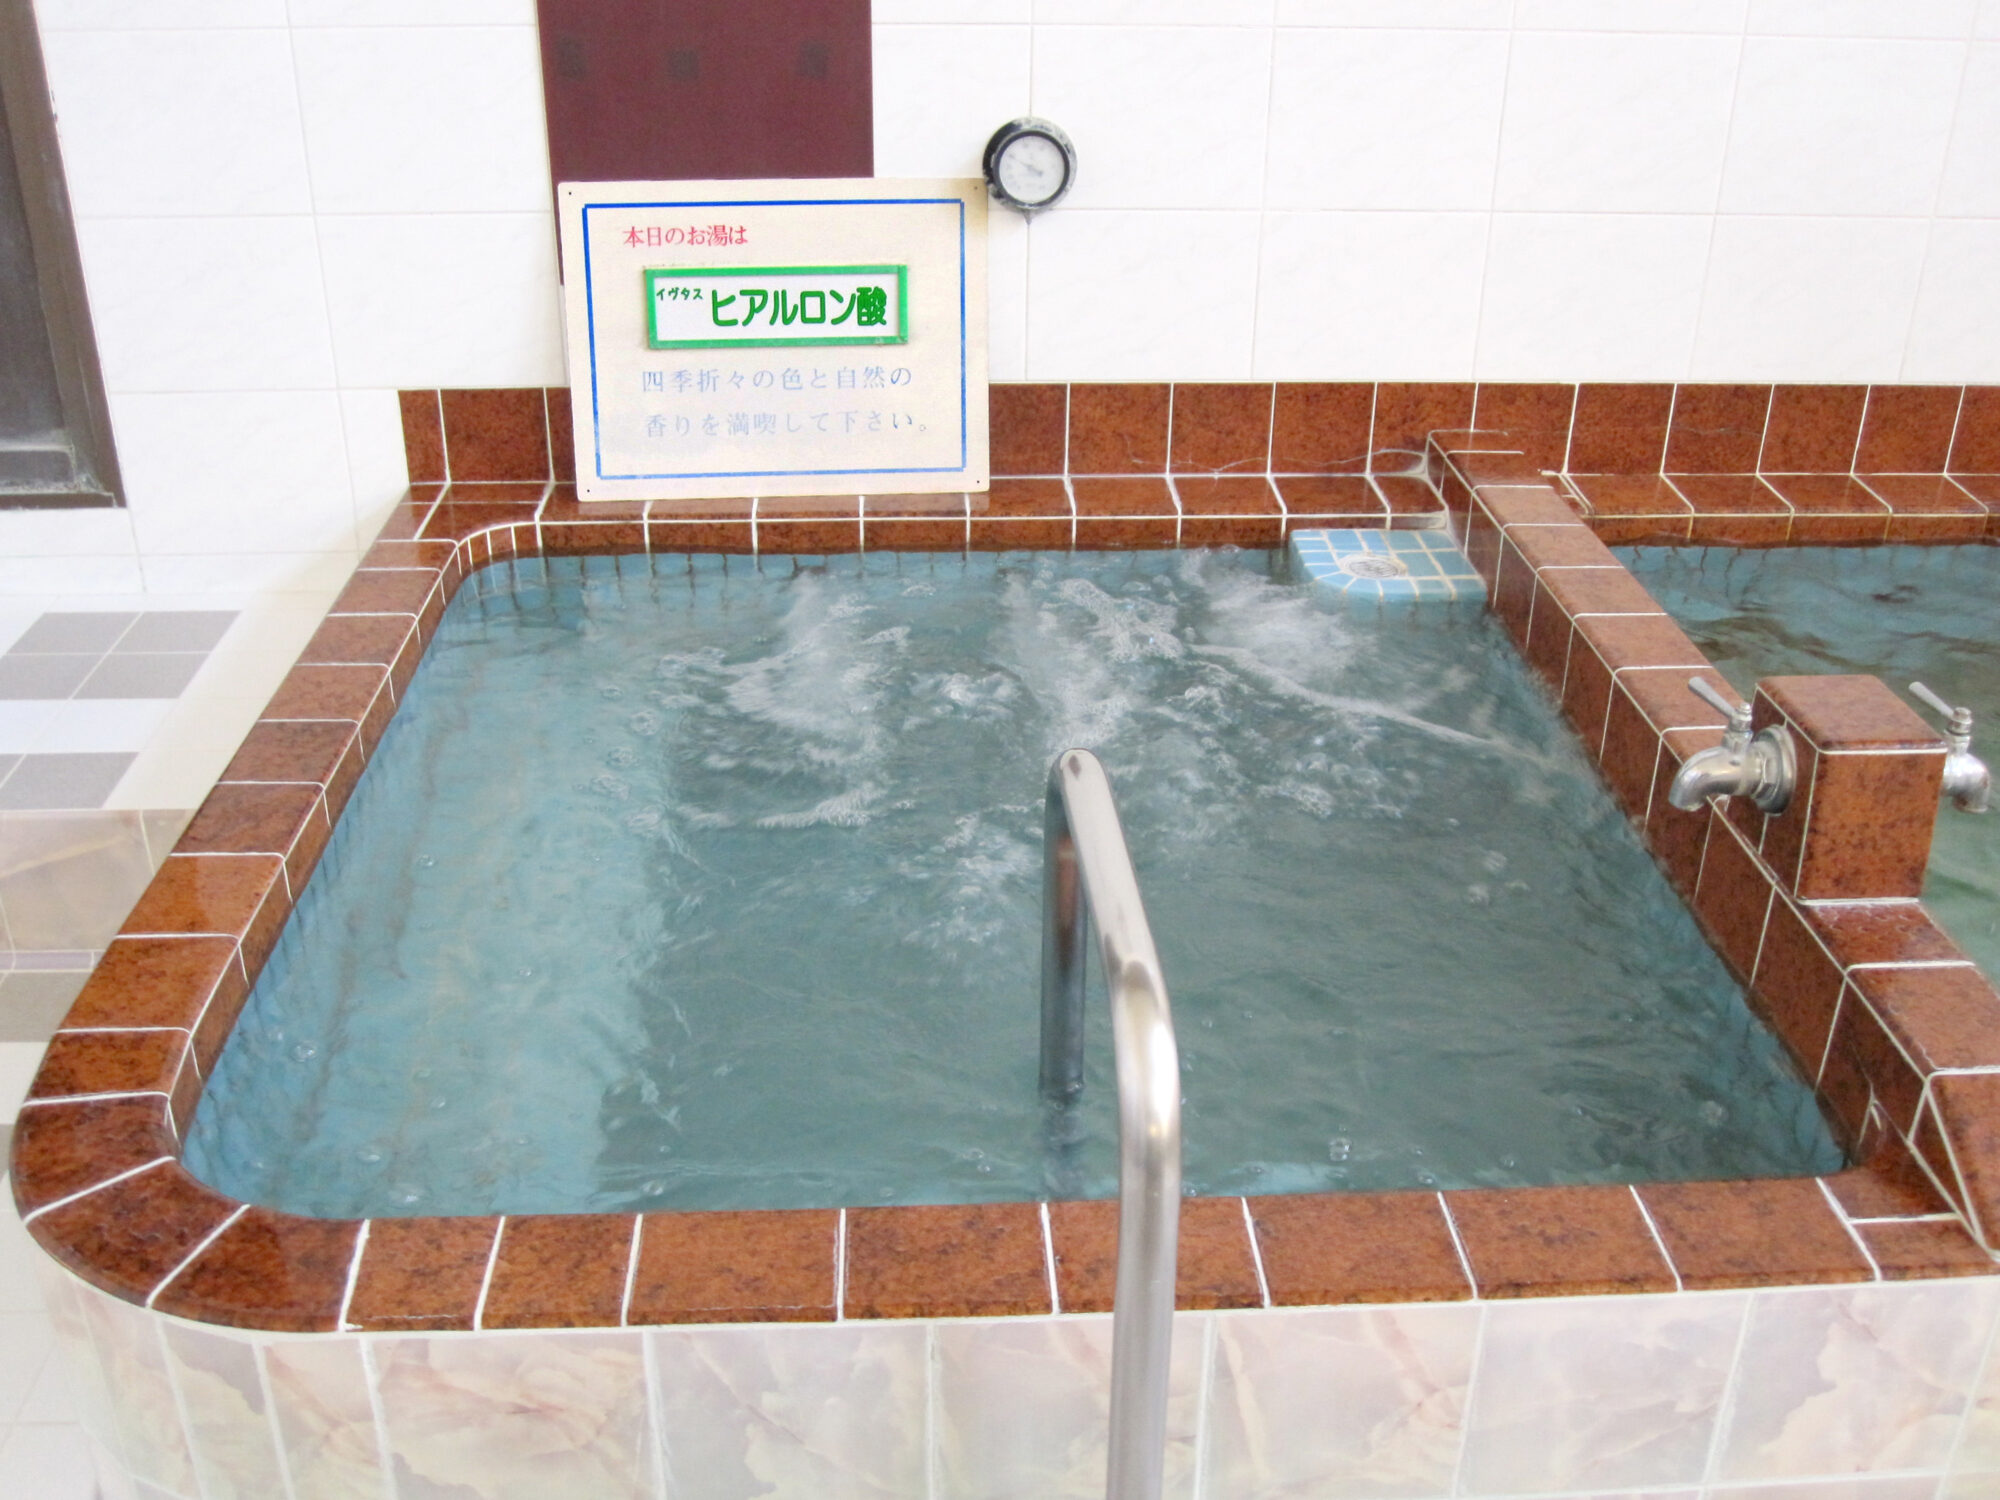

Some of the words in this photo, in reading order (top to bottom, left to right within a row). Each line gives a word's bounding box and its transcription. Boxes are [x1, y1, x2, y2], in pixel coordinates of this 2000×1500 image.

[624, 225, 747, 247] 本日のお湯は
[656, 287, 703, 300] イヴタス
[711, 286, 888, 326] ヒアルロン酸
[643, 367, 912, 392] 四季折々の色と自然の
